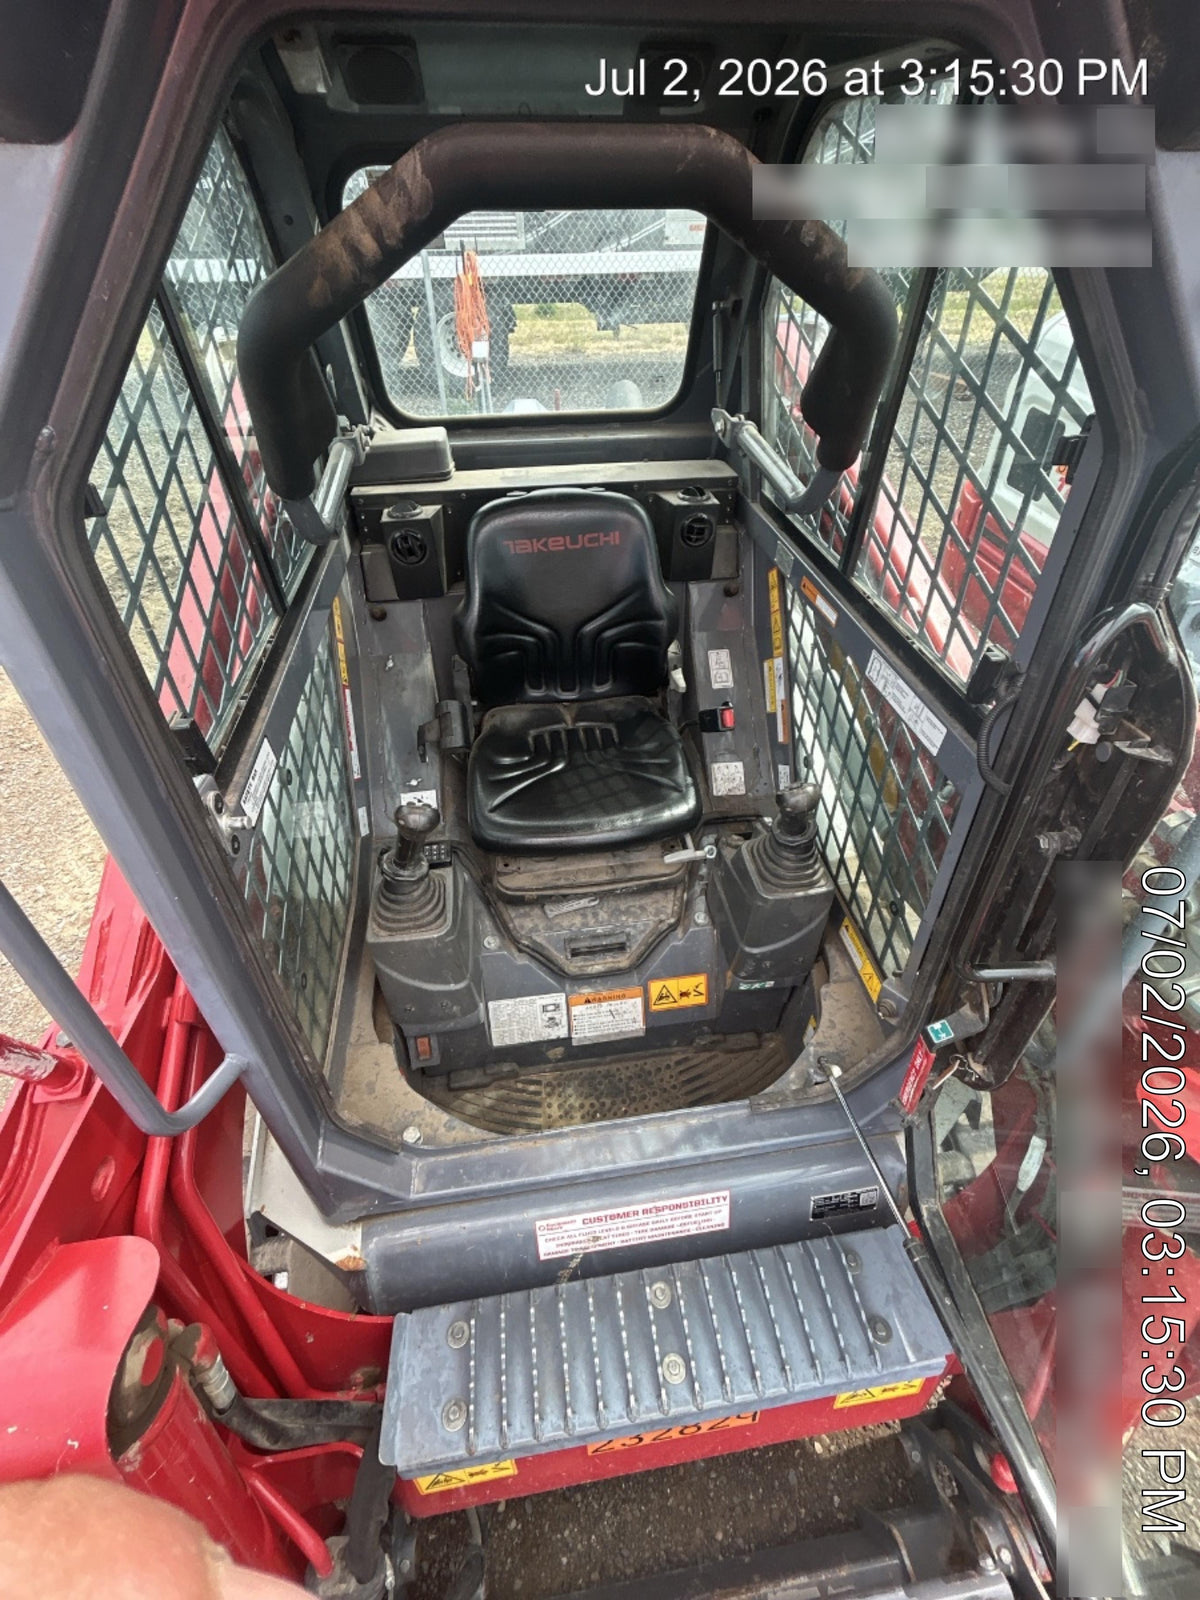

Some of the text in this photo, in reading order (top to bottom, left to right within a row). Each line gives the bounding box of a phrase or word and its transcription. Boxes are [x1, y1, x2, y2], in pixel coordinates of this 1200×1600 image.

[503, 531, 620, 554] TAKEUCHI
[582, 1195, 728, 1226] CUSTOMER RESPONSIBILITY
